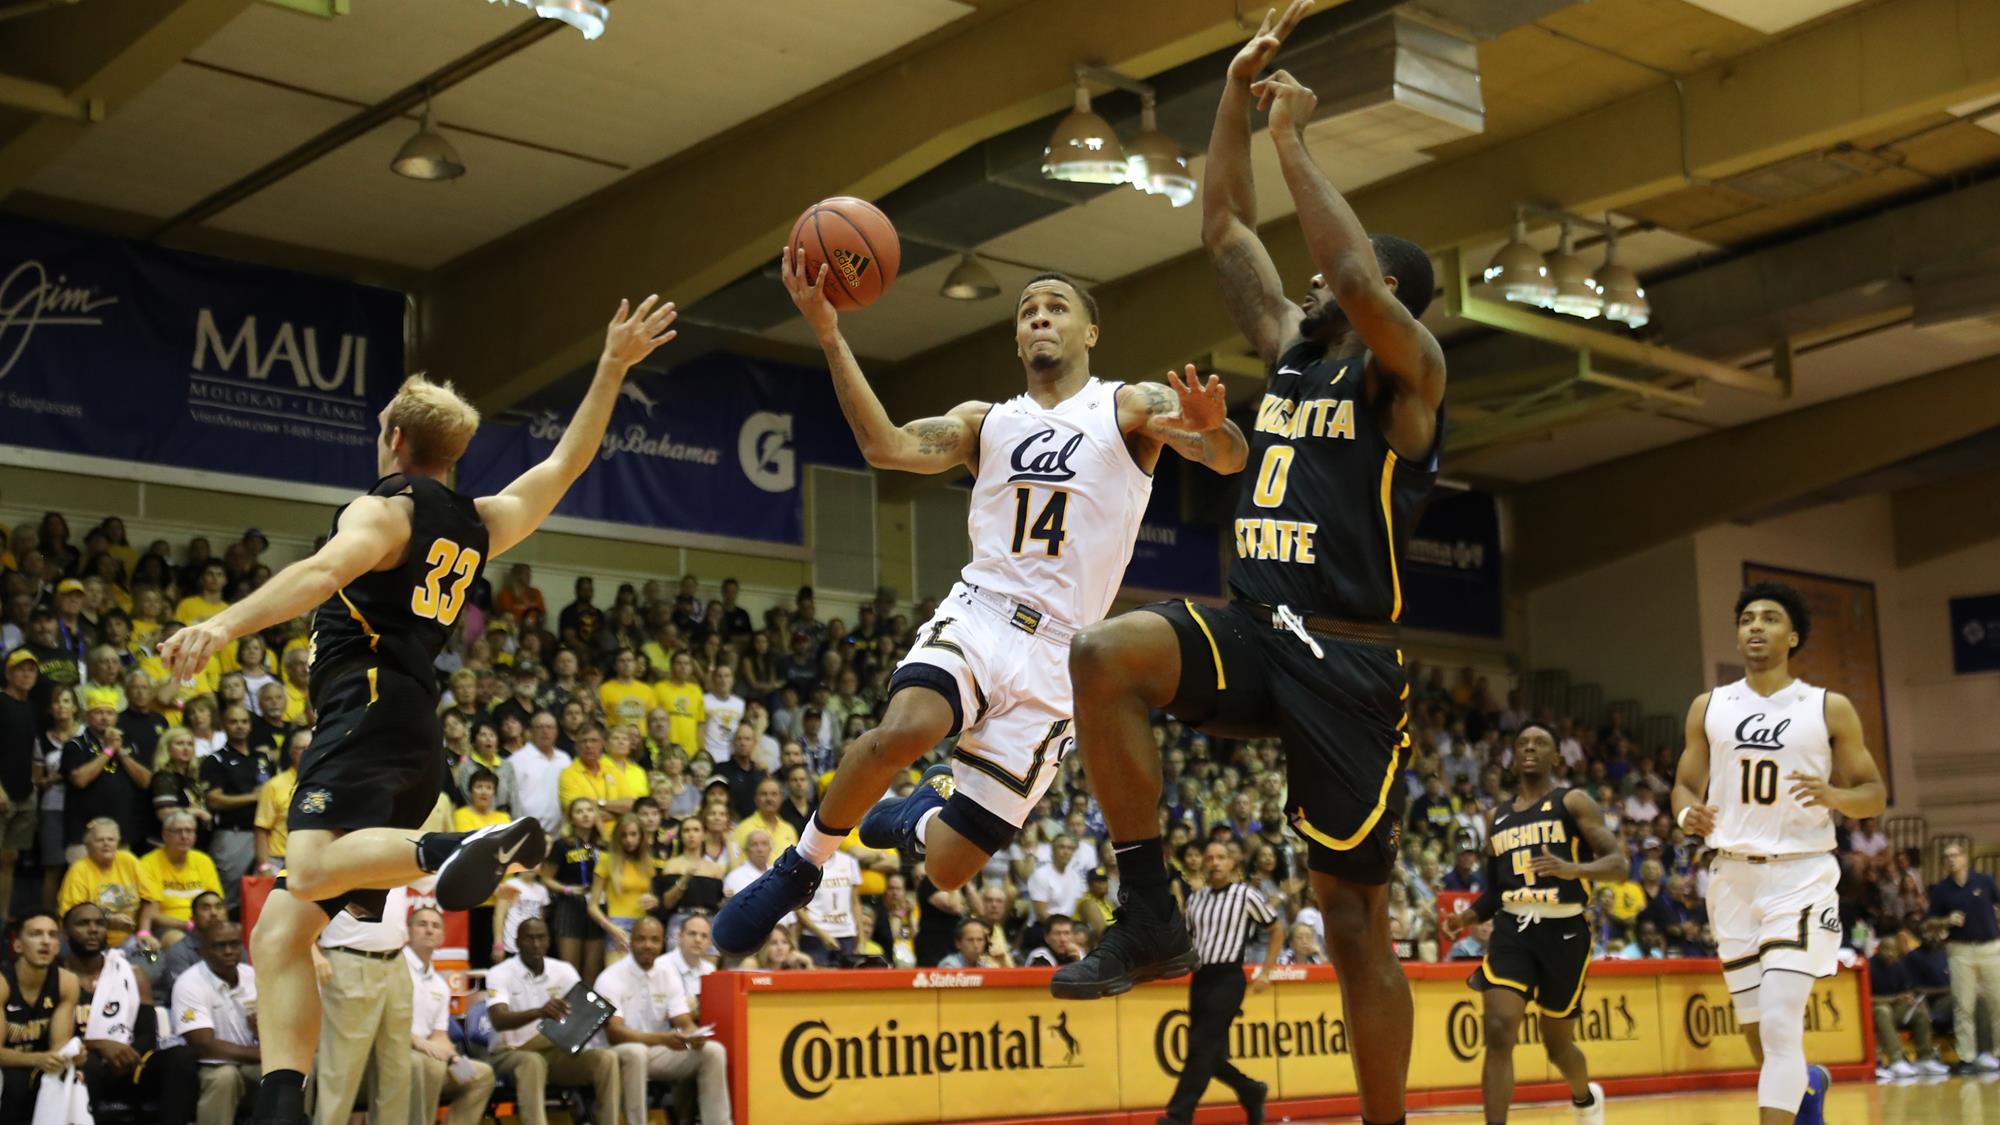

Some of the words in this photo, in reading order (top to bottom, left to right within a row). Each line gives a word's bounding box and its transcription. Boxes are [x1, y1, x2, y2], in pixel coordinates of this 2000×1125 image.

[833, 248, 860, 288] adidas
[192, 308, 367, 397] MAUI
[738, 411, 797, 493] G
[1007, 429, 1084, 483] Cal
[1253, 445, 1295, 508] 0
[1011, 485, 1069, 558] 14
[1235, 518, 1318, 564] STATE
[411, 537, 481, 626] 33
[1734, 713, 1792, 751] Cal
[1740, 757, 1780, 806] 10
[1490, 820, 1567, 857] WICHITA
[1511, 848, 1536, 887] 4
[780, 1018, 1044, 1101] Continental
[1155, 1009, 1350, 1079] Coinenta
